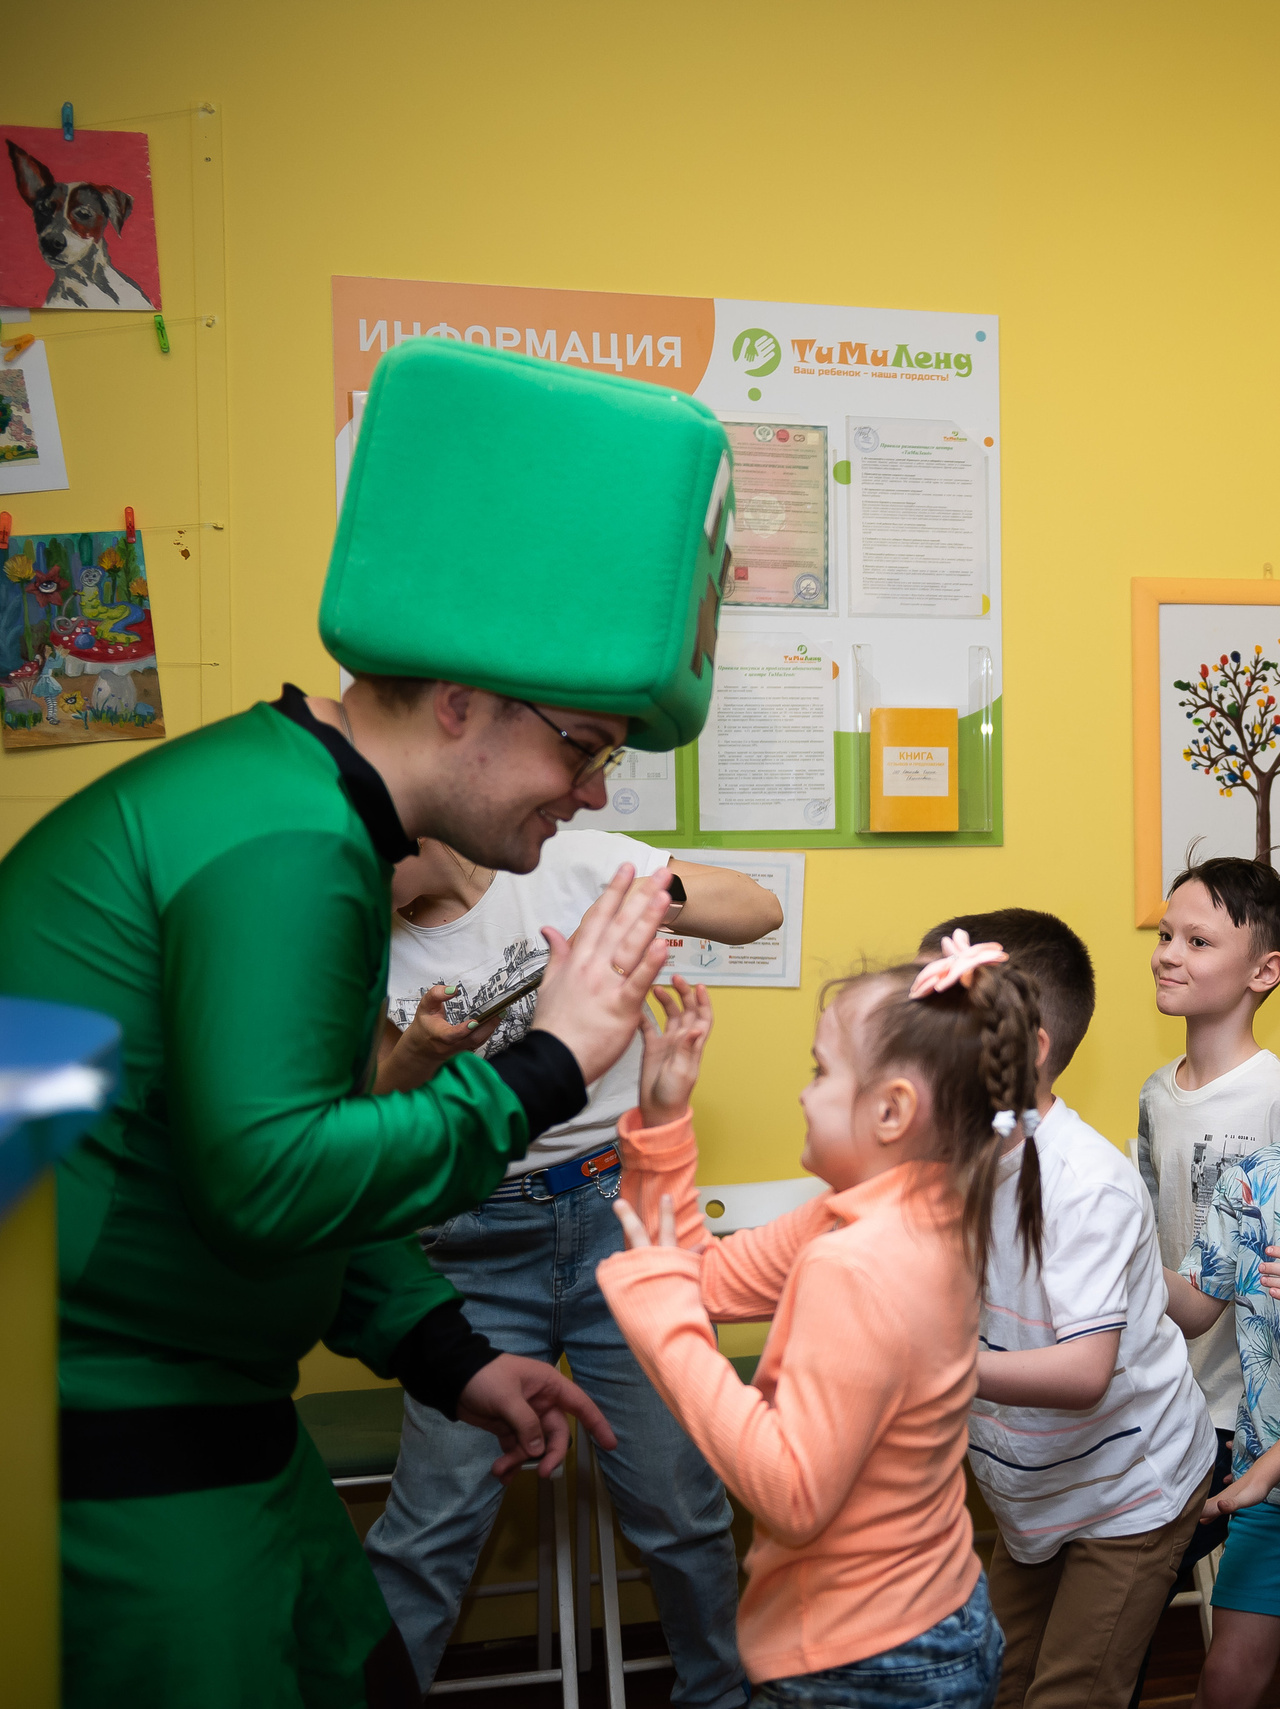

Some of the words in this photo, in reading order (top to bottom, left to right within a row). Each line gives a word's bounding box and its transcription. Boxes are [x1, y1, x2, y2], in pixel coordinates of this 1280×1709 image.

[790, 338, 972, 378] ТиМиЛенд
[793, 366, 815, 375] Ваш
[818, 367, 861, 377] ребенок
[871, 371, 897, 379] наша
[900, 373, 950, 382] гордость!
[899, 752, 934, 760] КНИГА
